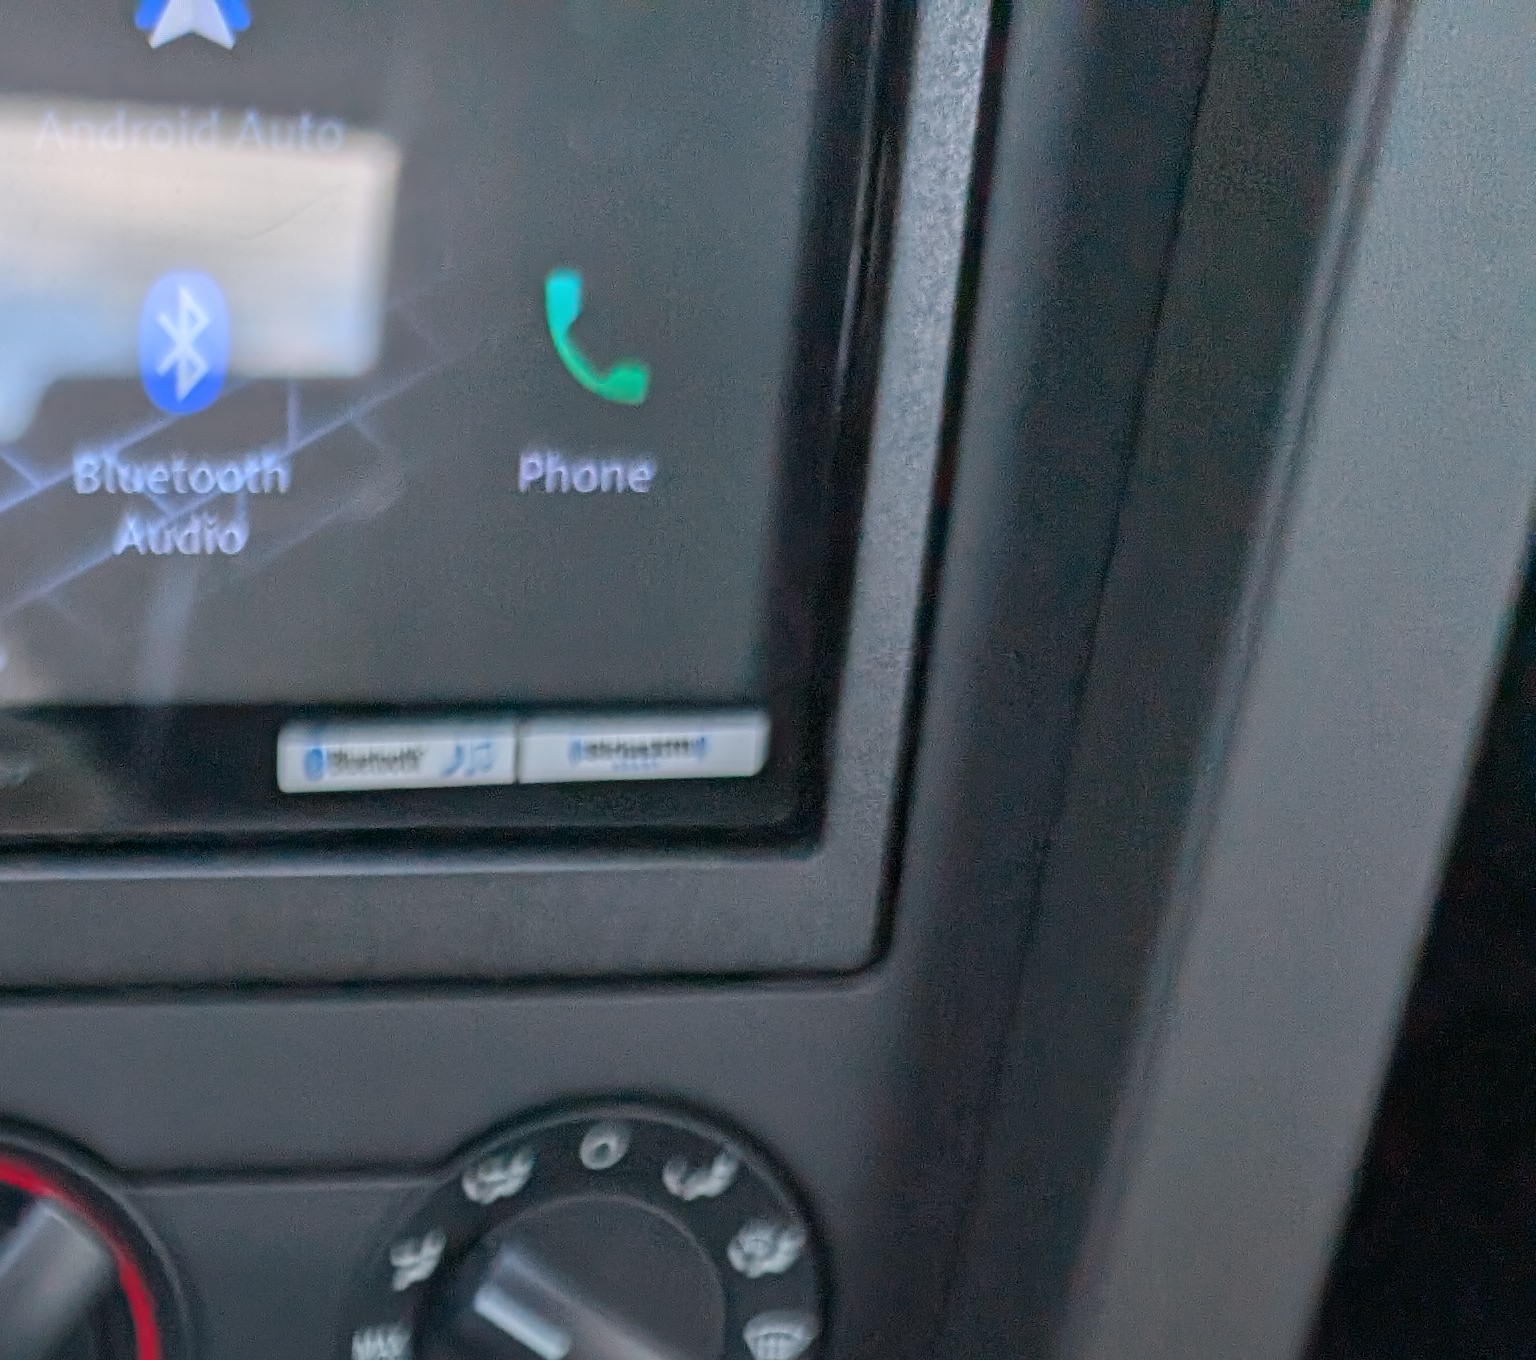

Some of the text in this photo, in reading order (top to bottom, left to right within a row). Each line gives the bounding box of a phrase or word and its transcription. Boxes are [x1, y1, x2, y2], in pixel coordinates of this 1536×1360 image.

[34, 106, 345, 151] Android Auto
[73, 453, 293, 494] Bluetooth
[519, 450, 657, 494] Phone
[113, 511, 249, 556] Audio
